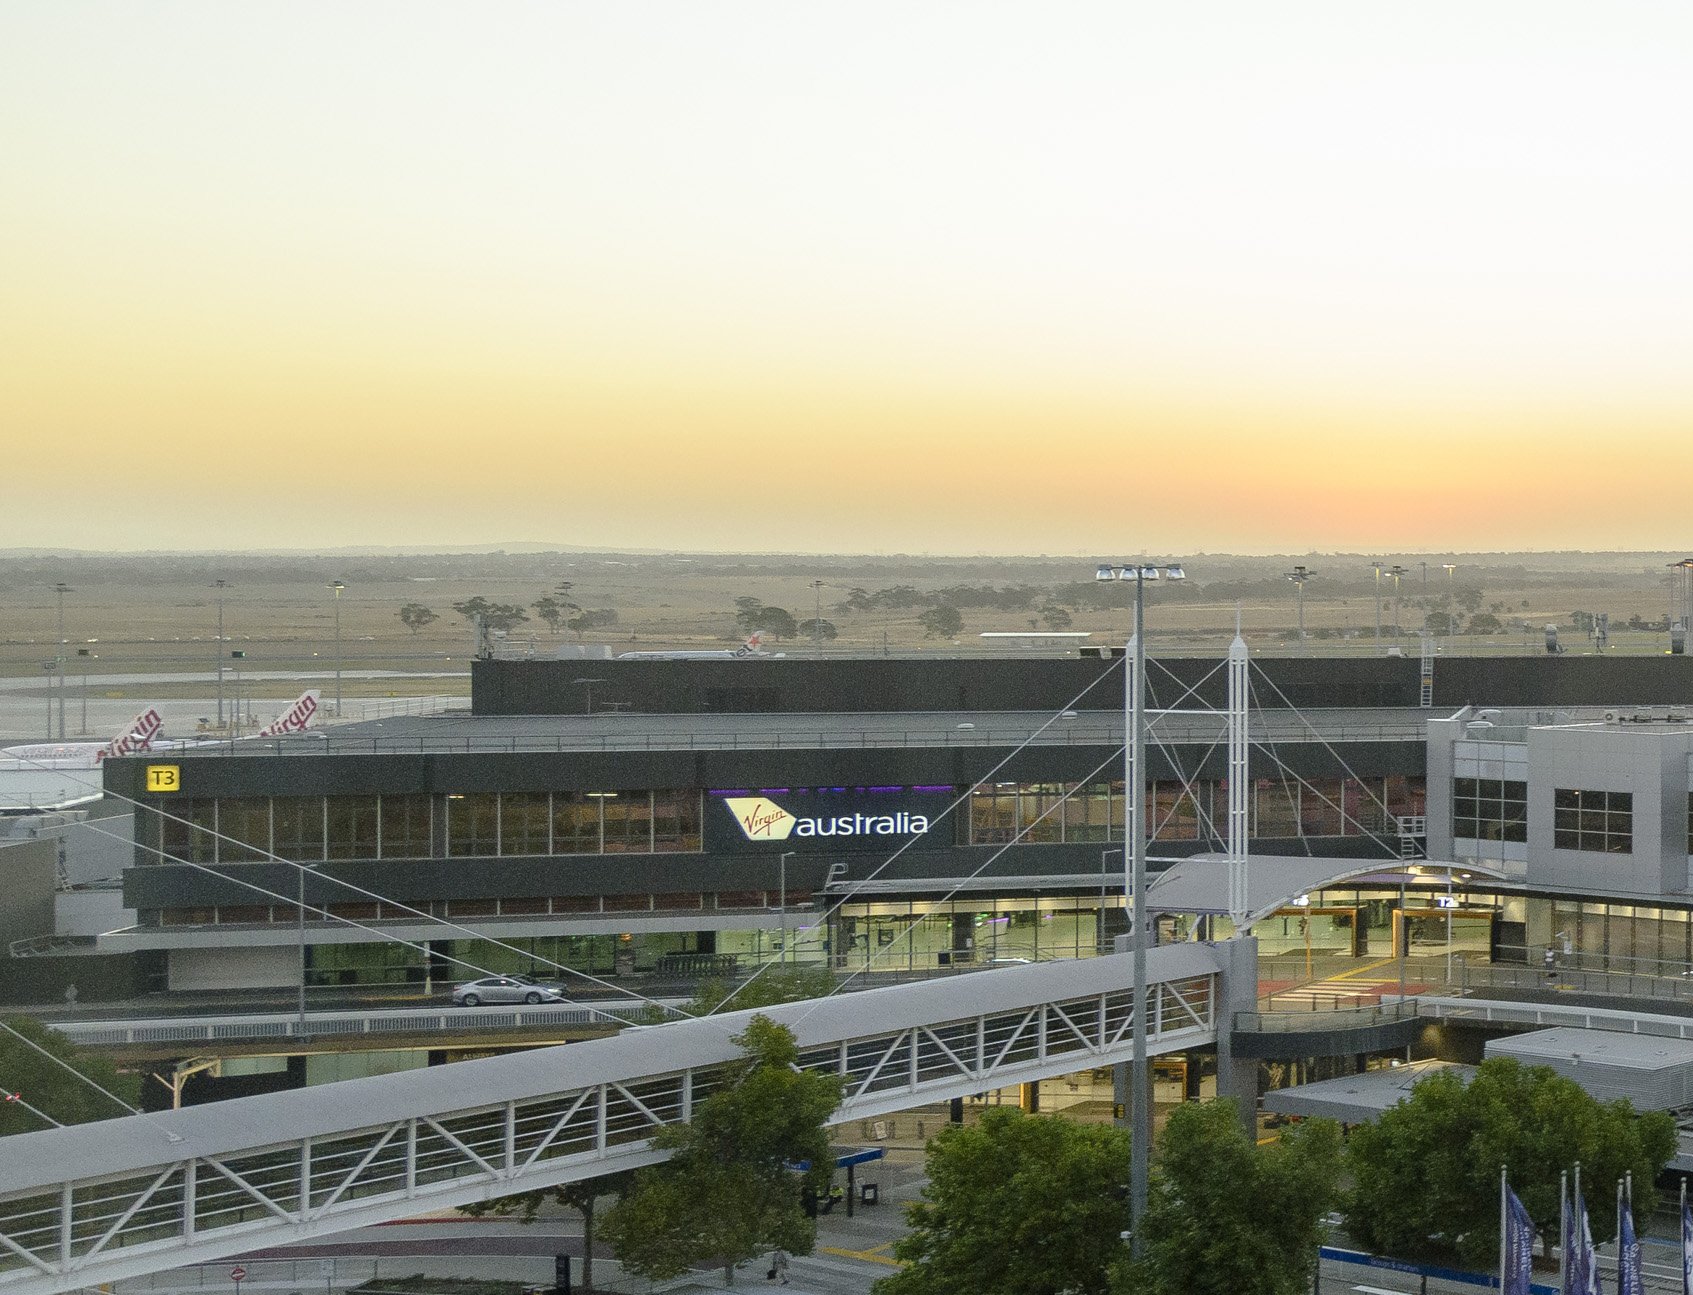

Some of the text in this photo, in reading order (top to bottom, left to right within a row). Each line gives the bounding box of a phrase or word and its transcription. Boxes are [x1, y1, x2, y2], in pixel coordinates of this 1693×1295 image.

[152, 771, 175, 785] T3
[744, 804, 928, 837] Virgin australia
